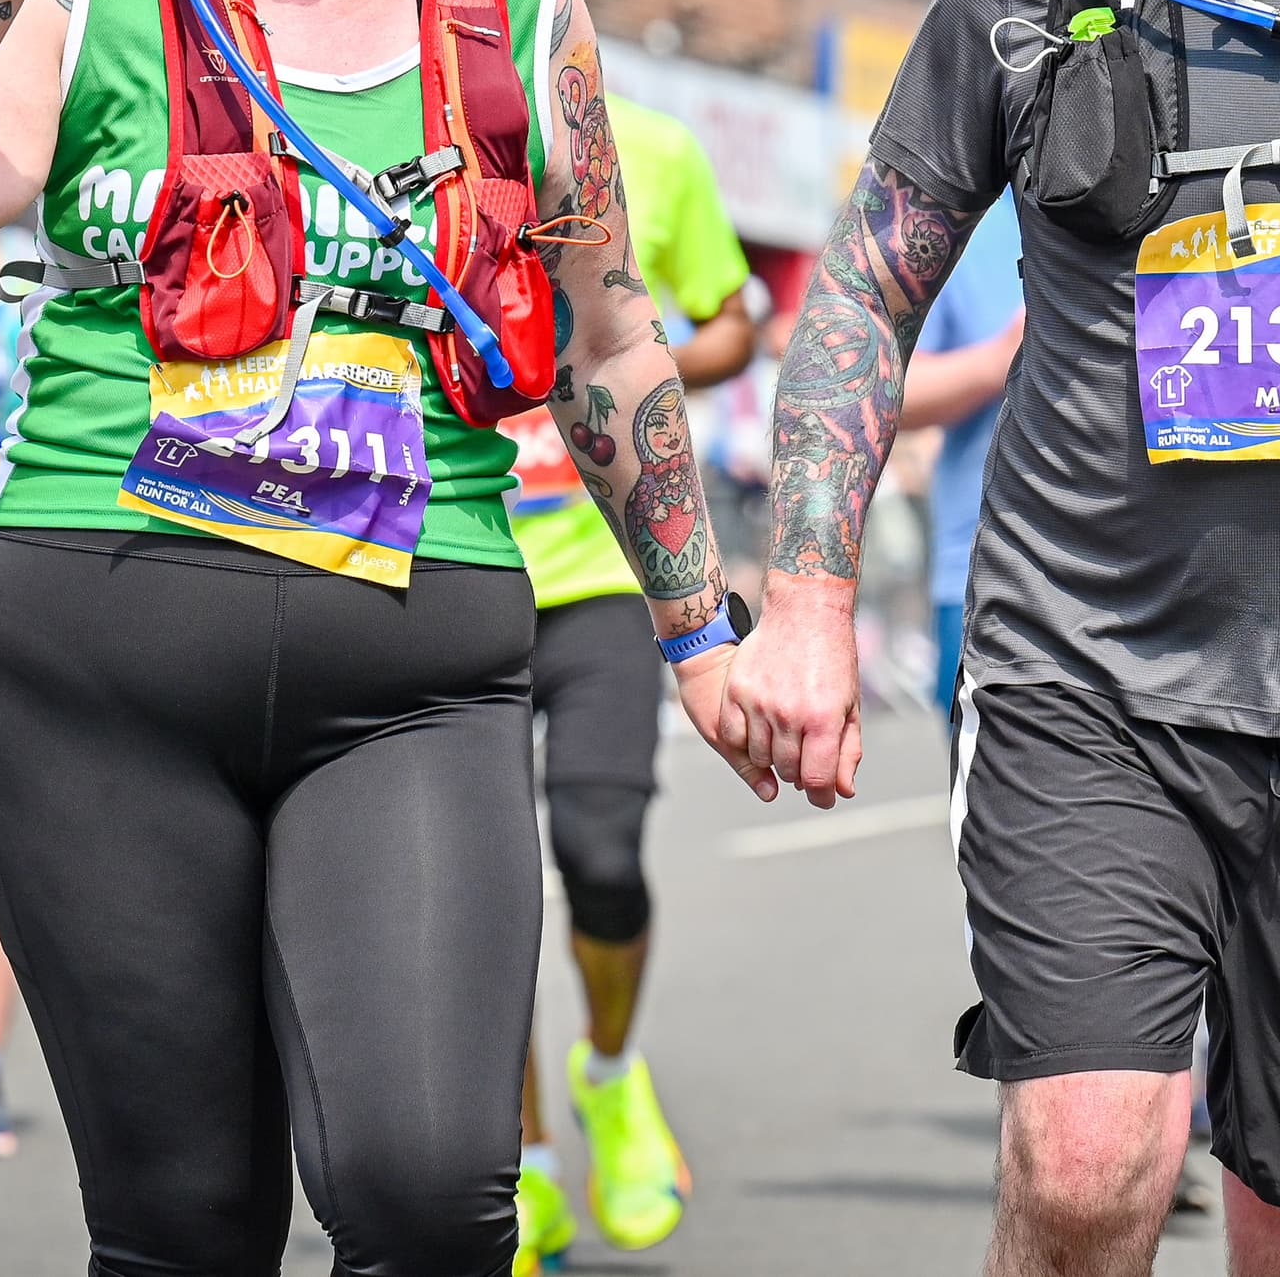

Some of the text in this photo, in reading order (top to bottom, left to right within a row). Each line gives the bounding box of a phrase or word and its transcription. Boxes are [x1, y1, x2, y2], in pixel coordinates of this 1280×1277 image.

[238, 374, 283, 395] HAL
[1166, 378, 1177, 399] L
[1158, 434, 1231, 447] RUN FOR ALL
[166, 446, 178, 461] L
[140, 476, 156, 486] Jane
[135, 483, 212, 516] RUN FOR ALL
[256, 480, 304, 507] PEA
[363, 553, 398, 571] Leeds
